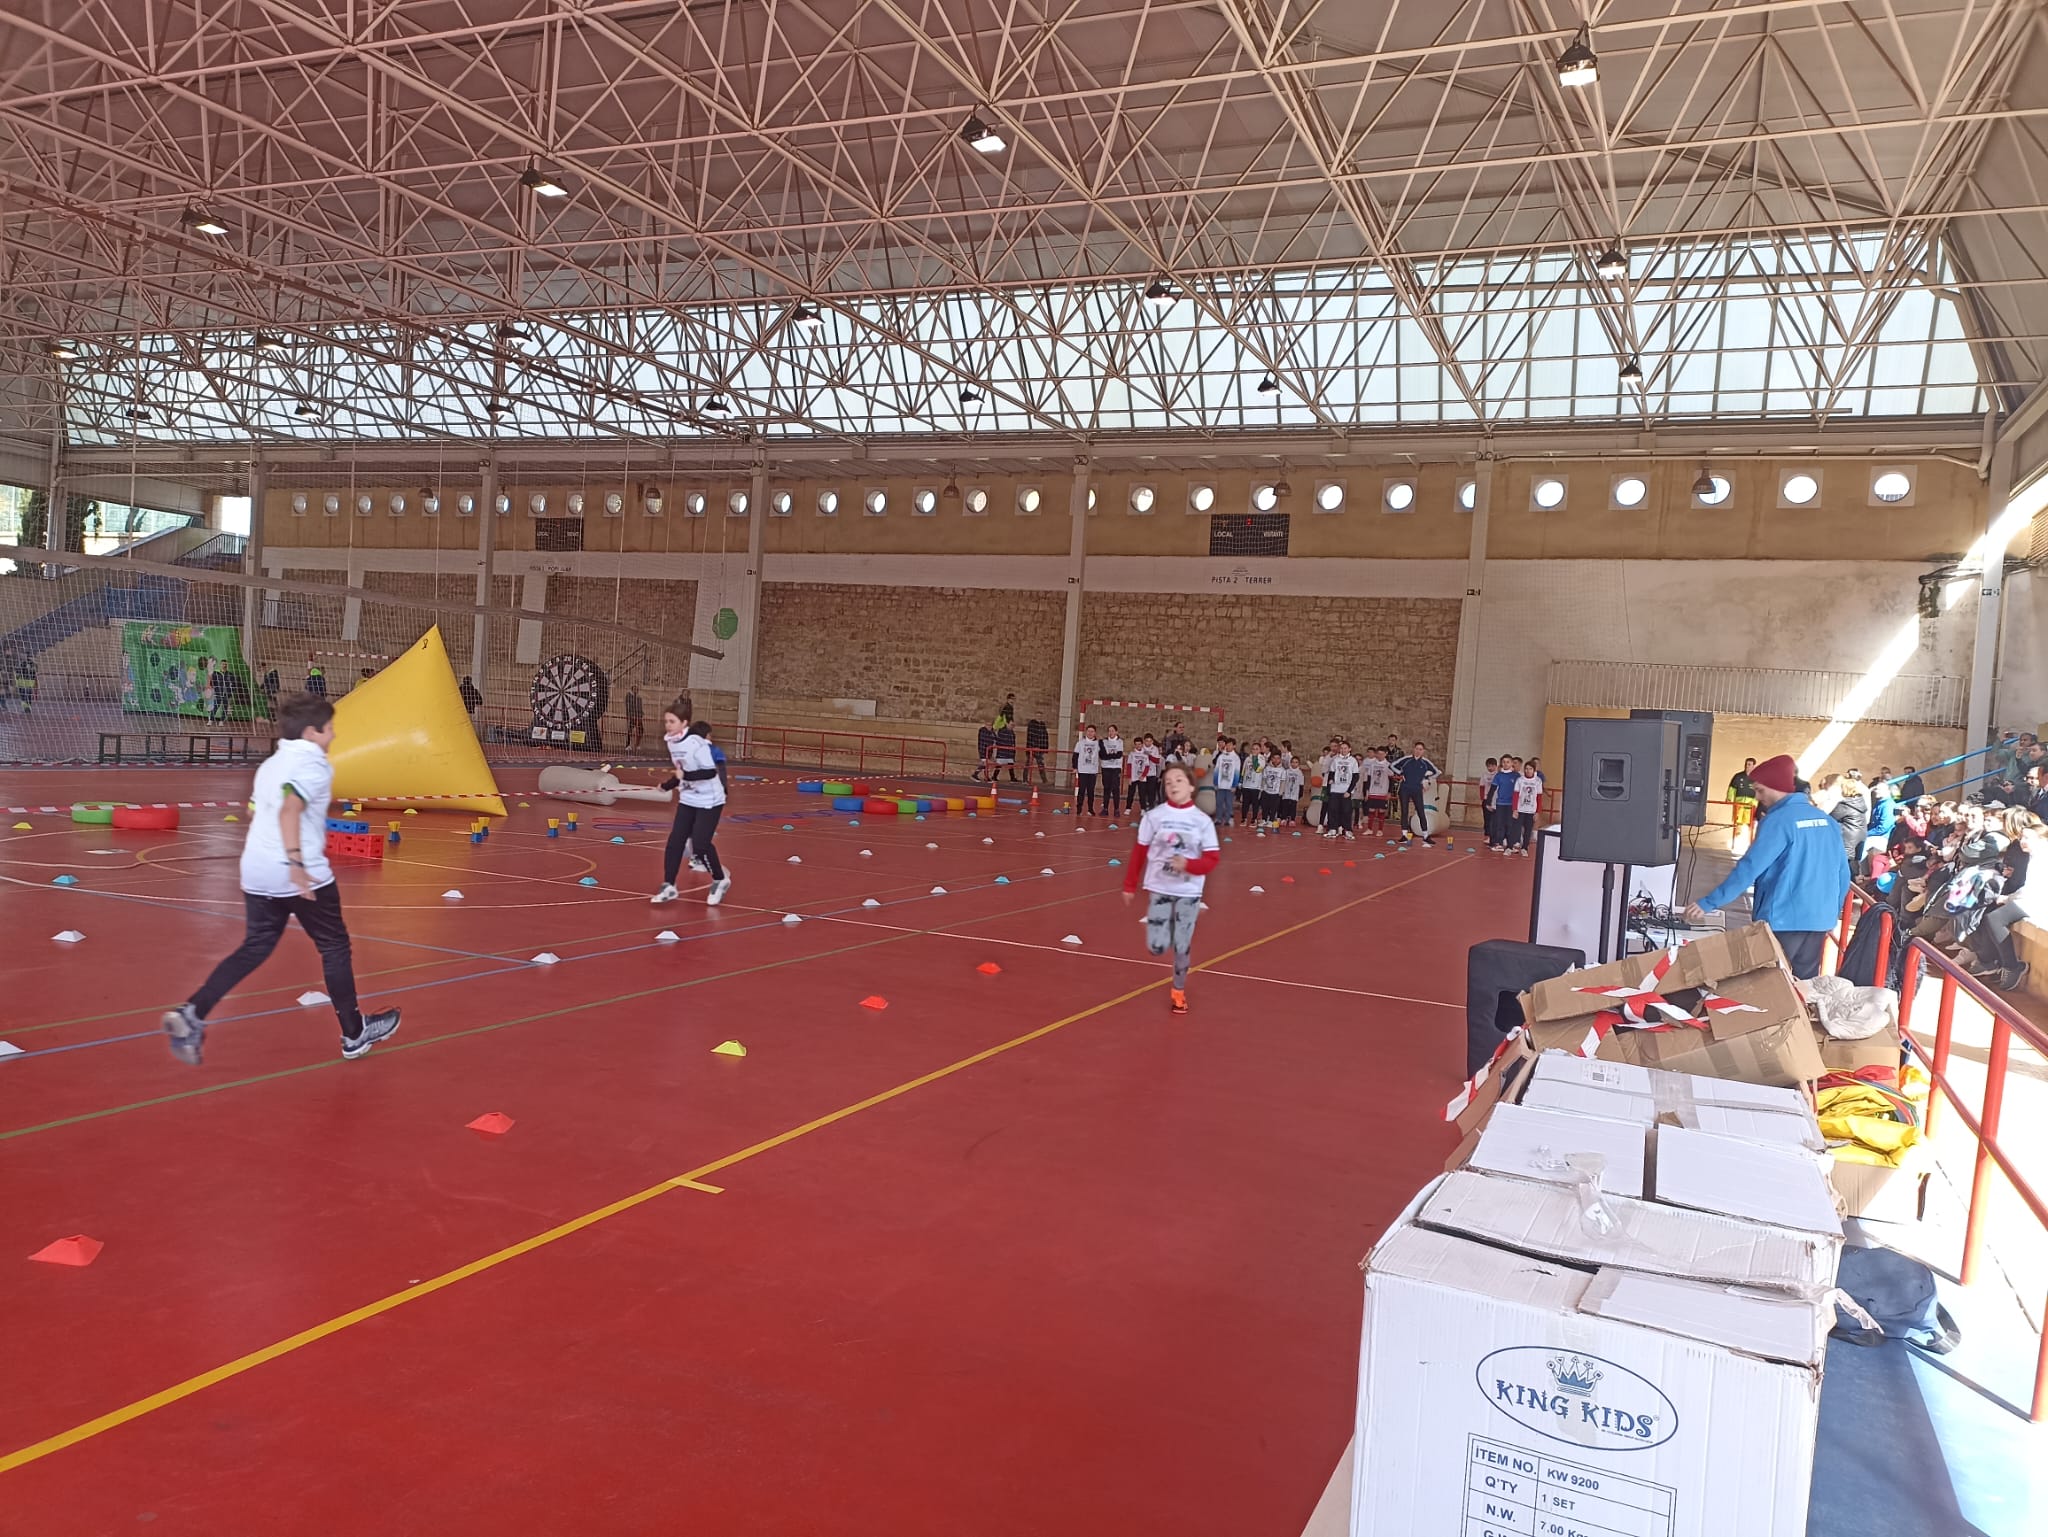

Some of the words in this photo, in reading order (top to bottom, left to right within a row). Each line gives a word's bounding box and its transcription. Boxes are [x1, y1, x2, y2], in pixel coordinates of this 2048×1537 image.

[1211, 576, 1231, 584] PISTA
[1245, 576, 1273, 585] TERRER
[1496, 1379, 1571, 1419] KING
[1581, 1401, 1654, 1438] KIDS
[1475, 1446, 1509, 1467] ITEM
[1512, 1458, 1538, 1475] NO.
[1484, 1475, 1518, 1494] Q'TY
[1547, 1468, 1568, 1482] KW
[1570, 1474, 1600, 1491] 9200
[1541, 1493, 1547, 1503] 1
[1552, 1496, 1576, 1511] SET
[1486, 1503, 1517, 1523] N.W.
[1540, 1520, 1564, 1536] 7.00
